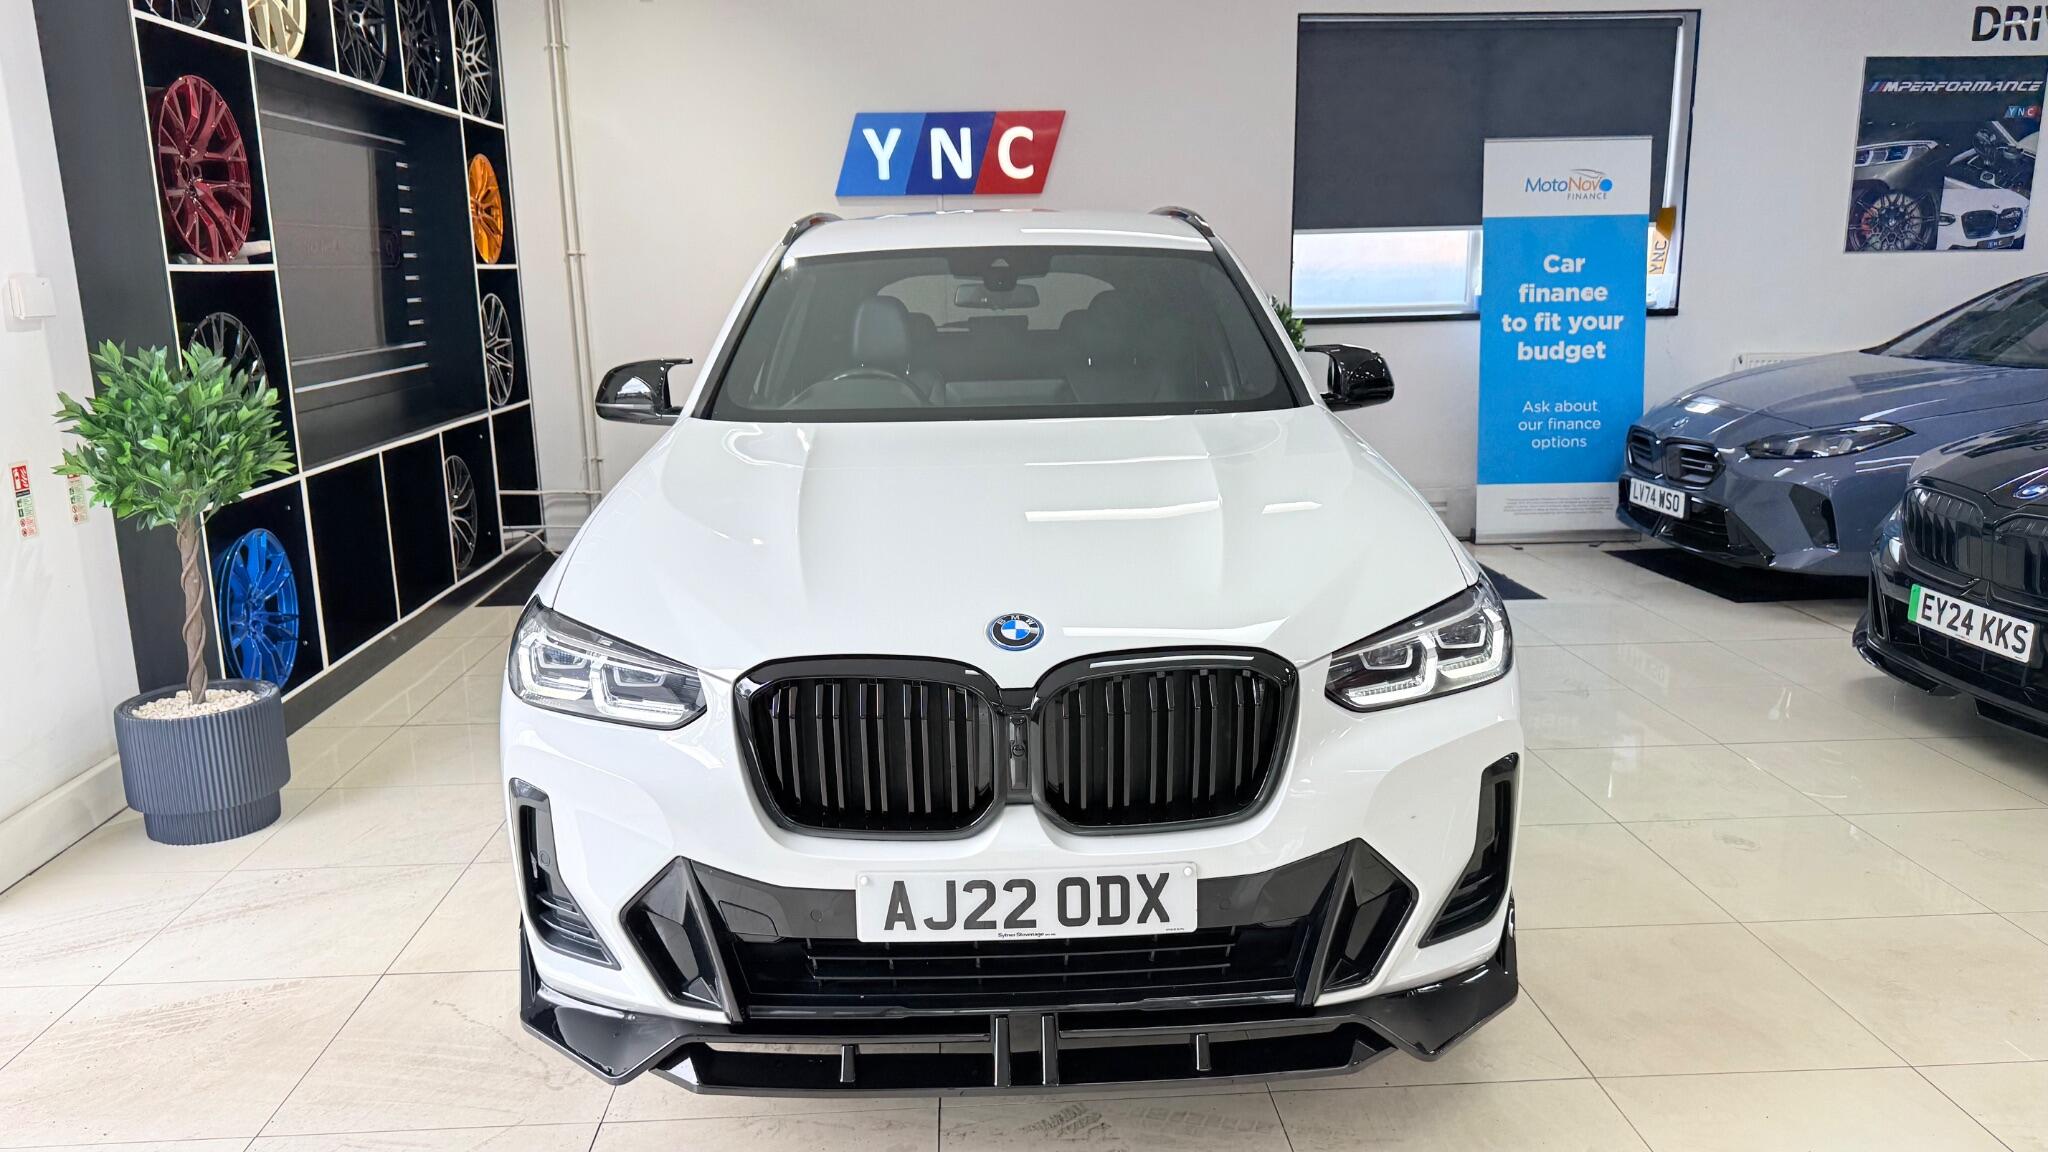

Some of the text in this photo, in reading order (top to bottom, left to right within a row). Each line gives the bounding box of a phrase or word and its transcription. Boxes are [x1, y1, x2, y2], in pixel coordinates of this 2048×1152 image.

[1971, 5, 2048, 41] DRI
[2009, 107, 2034, 117] YNC
[862, 126, 1035, 181] YNC
[1543, 254, 1586, 273] Car
[1649, 240, 1668, 273] YNC
[1518, 283, 1608, 303] finance
[1502, 312, 1624, 334] to fit your
[1517, 341, 1607, 363] budget
[1522, 400, 1598, 413] Ask about
[1518, 417, 1601, 431] our finance
[1531, 437, 1588, 450] options
[1633, 481, 1656, 505] LV74
[1921, 593, 2028, 654] EY24 KKS
[884, 872, 1170, 931] AJ22 ODX
